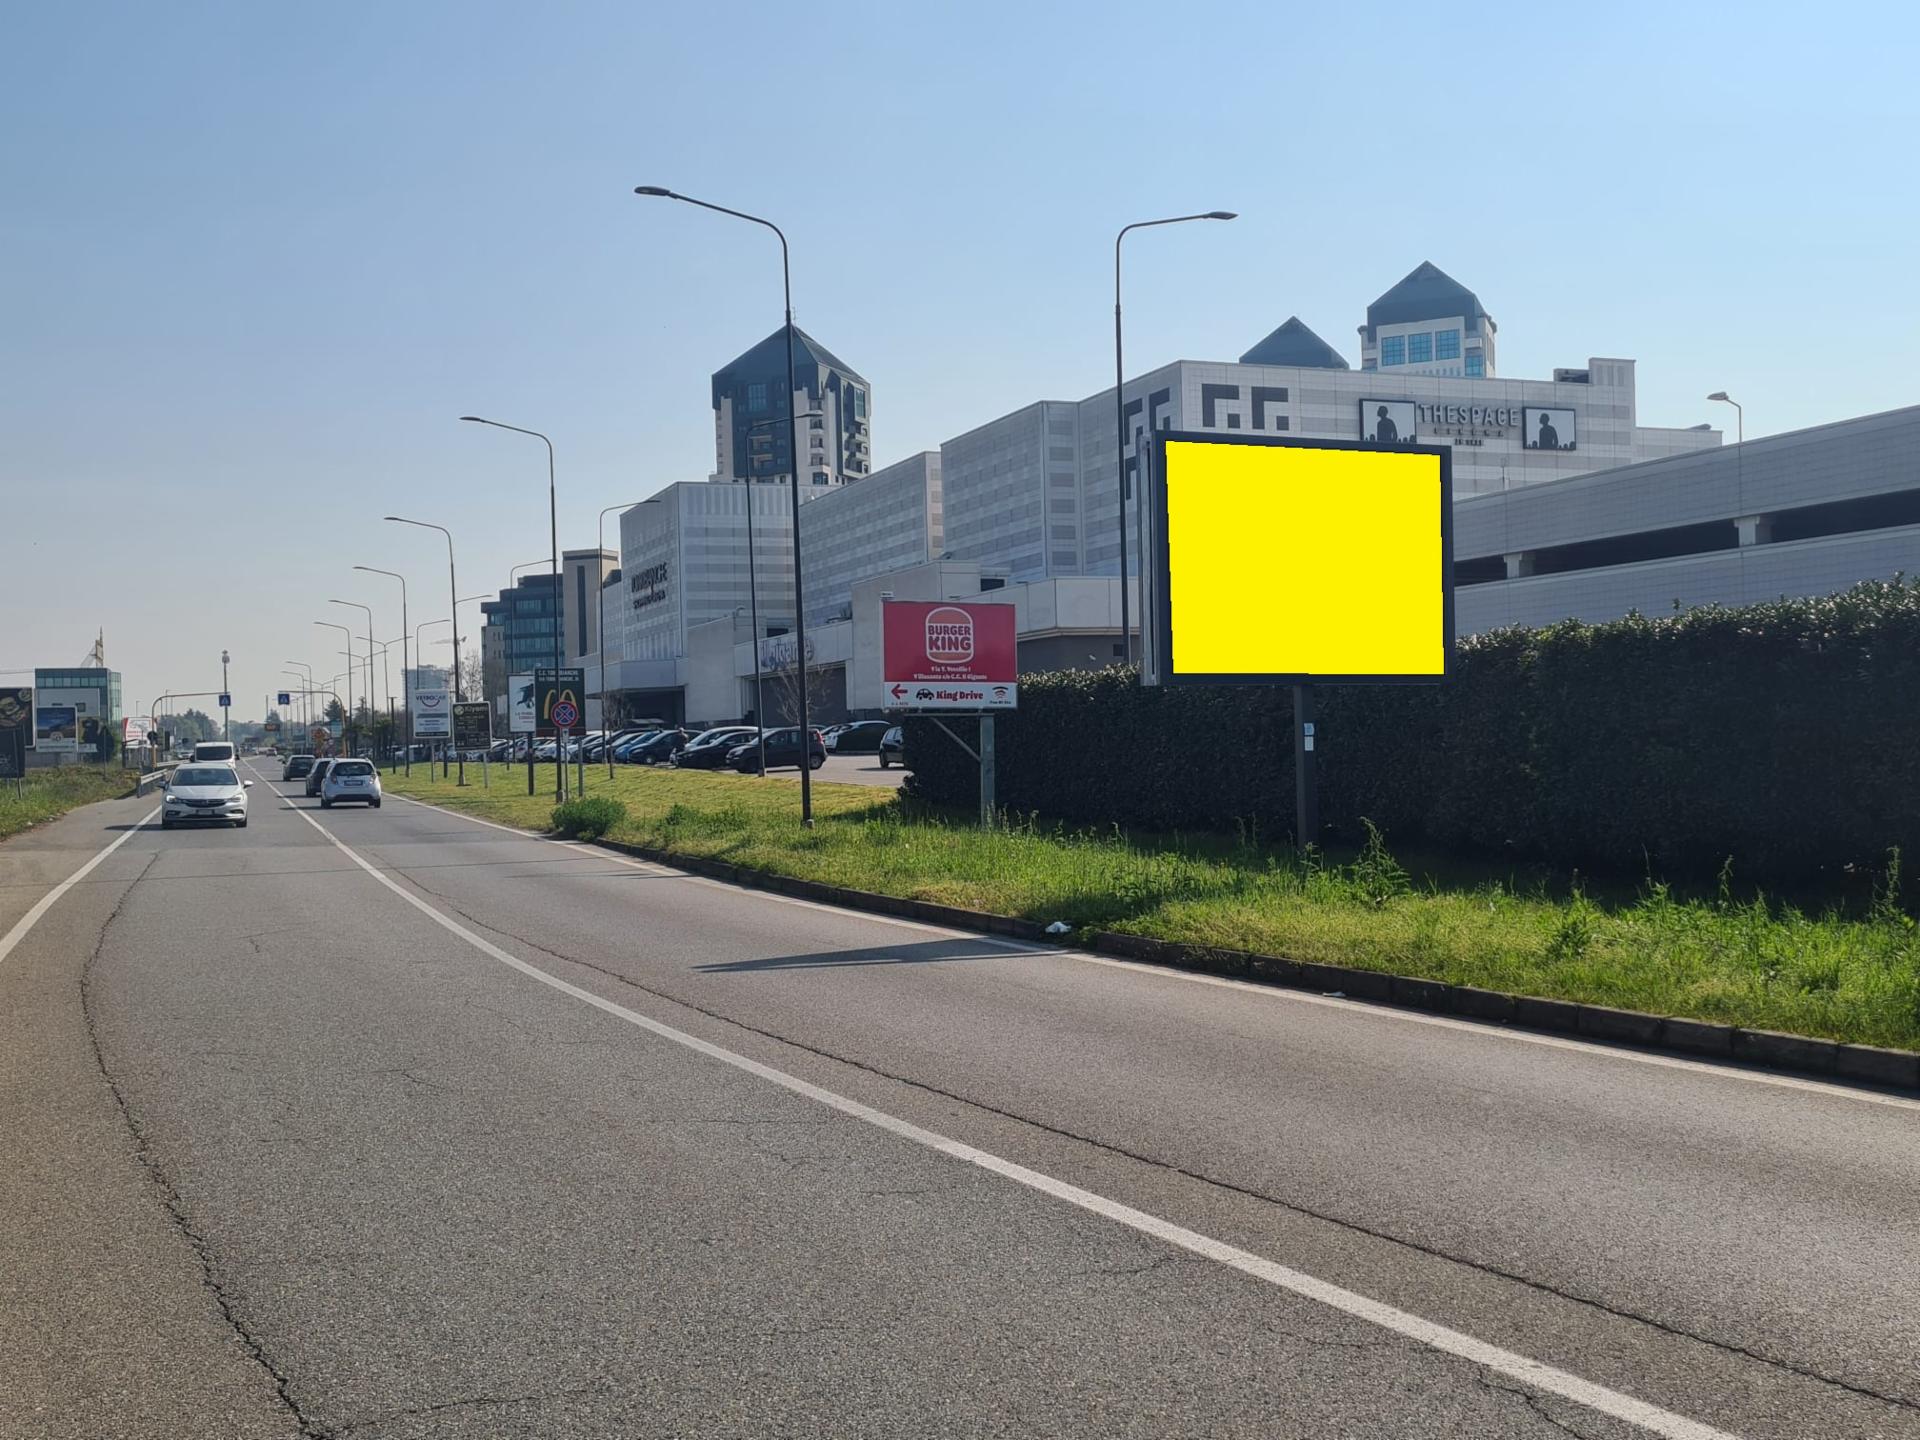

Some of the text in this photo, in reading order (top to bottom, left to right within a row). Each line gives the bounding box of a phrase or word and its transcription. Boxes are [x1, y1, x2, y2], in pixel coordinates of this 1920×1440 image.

[927, 625, 971, 636] BURGER
[927, 636, 971, 652] KING
[936, 690, 984, 702] King Drive
